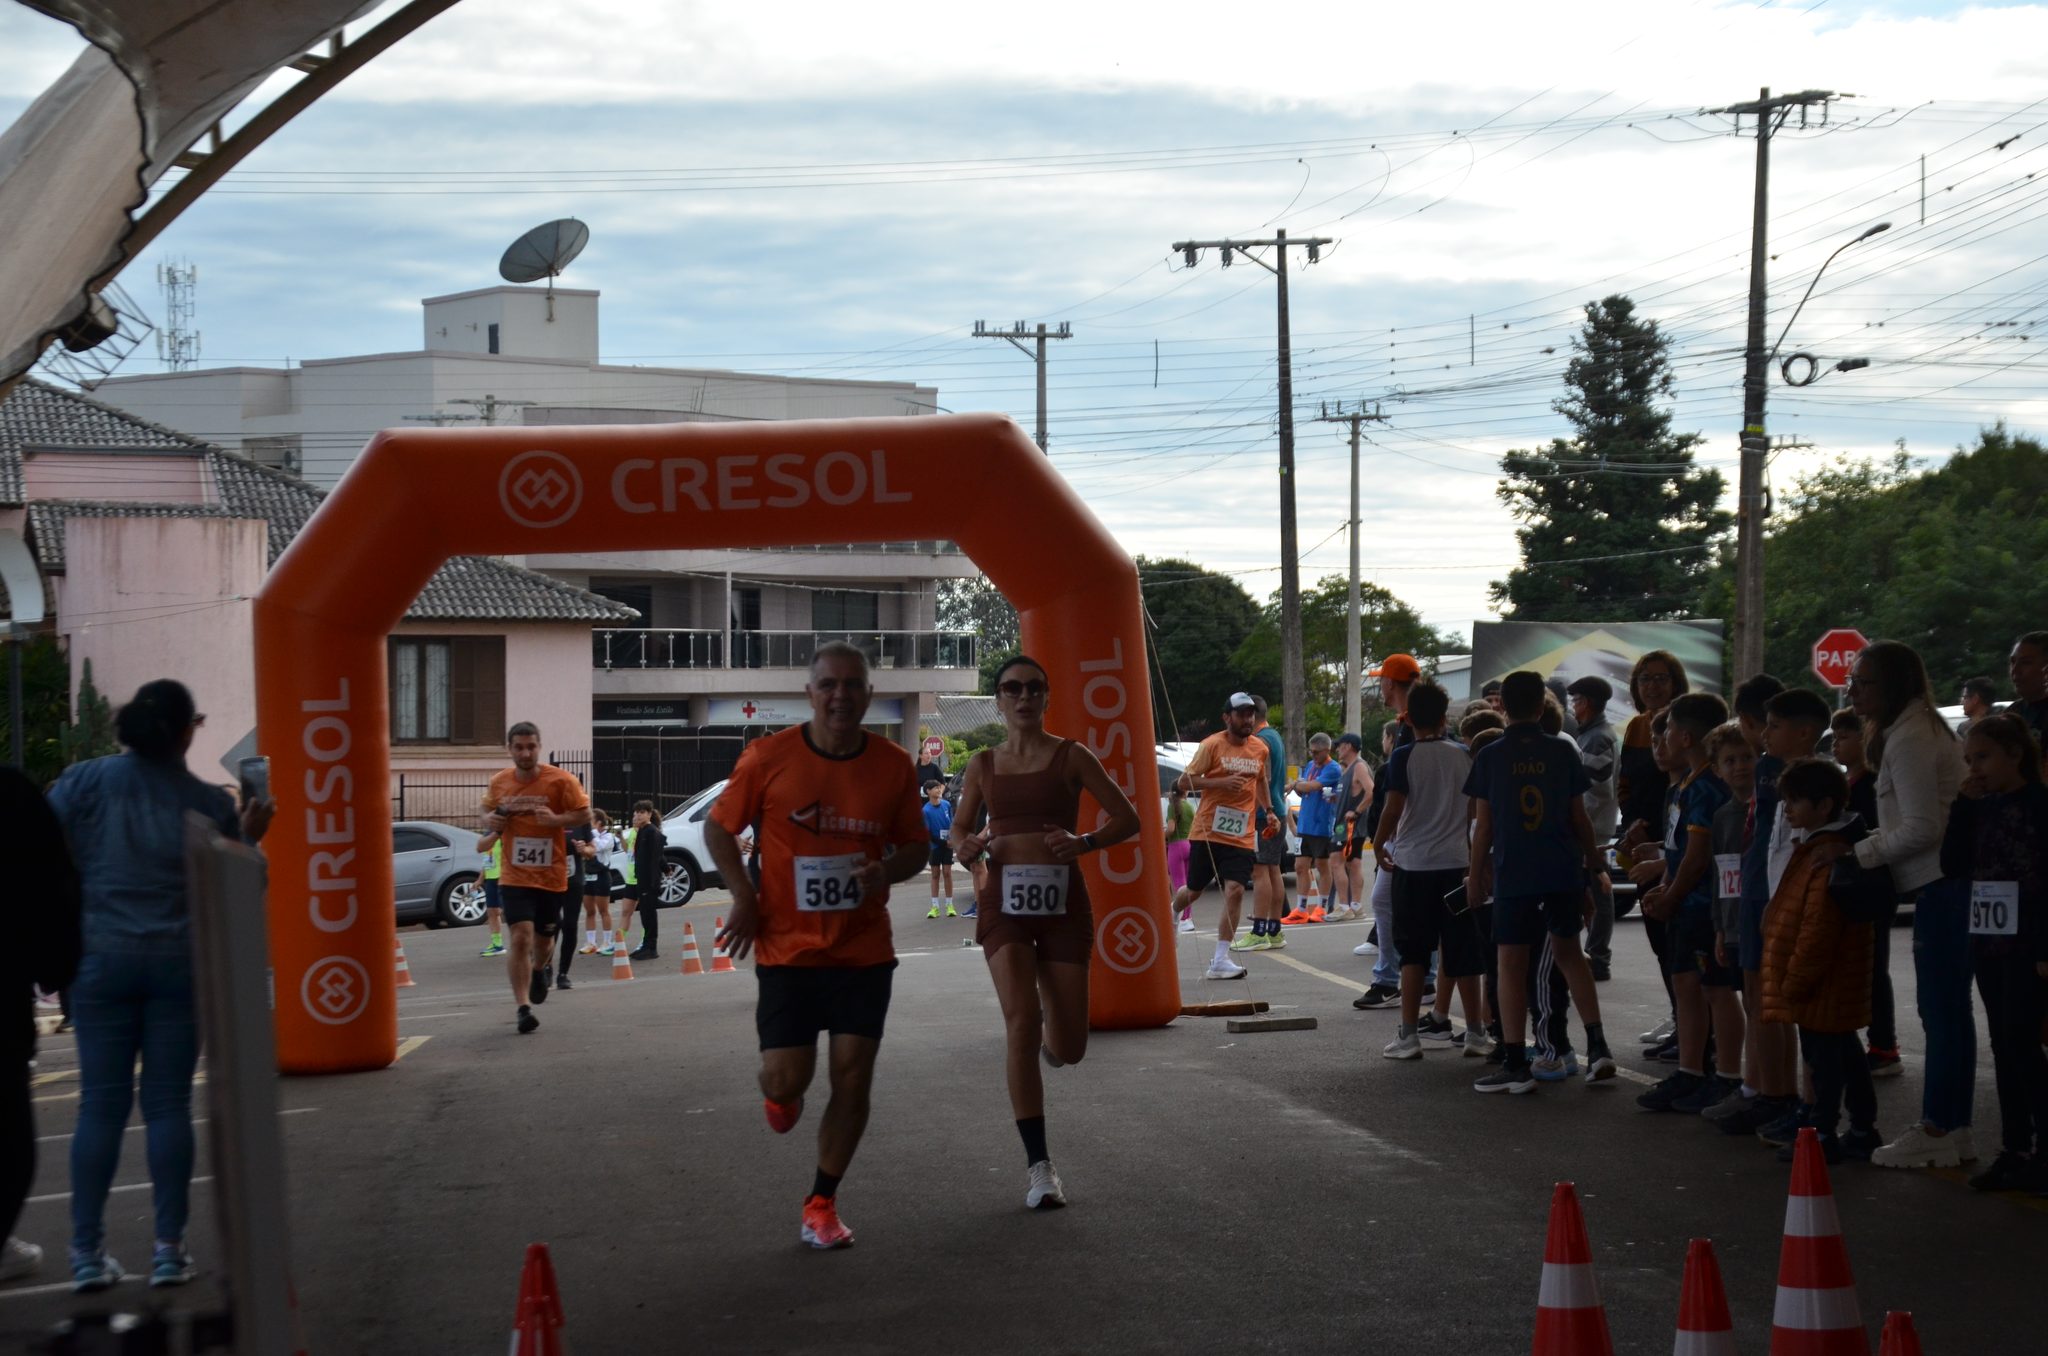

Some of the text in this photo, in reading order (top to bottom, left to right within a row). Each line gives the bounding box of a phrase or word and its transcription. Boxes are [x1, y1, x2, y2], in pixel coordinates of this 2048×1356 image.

[610, 449, 913, 514] CRESOL
[1818, 650, 1856, 667] PAR
[1080, 637, 1143, 884] CESOL
[302, 676, 358, 933] CRESOL
[1520, 784, 1544, 832] 9
[1217, 816, 1243, 834] 223
[517, 848, 546, 864] 541
[806, 877, 861, 906] 584
[1010, 884, 1059, 911] 580
[1973, 901, 2009, 929] 970
